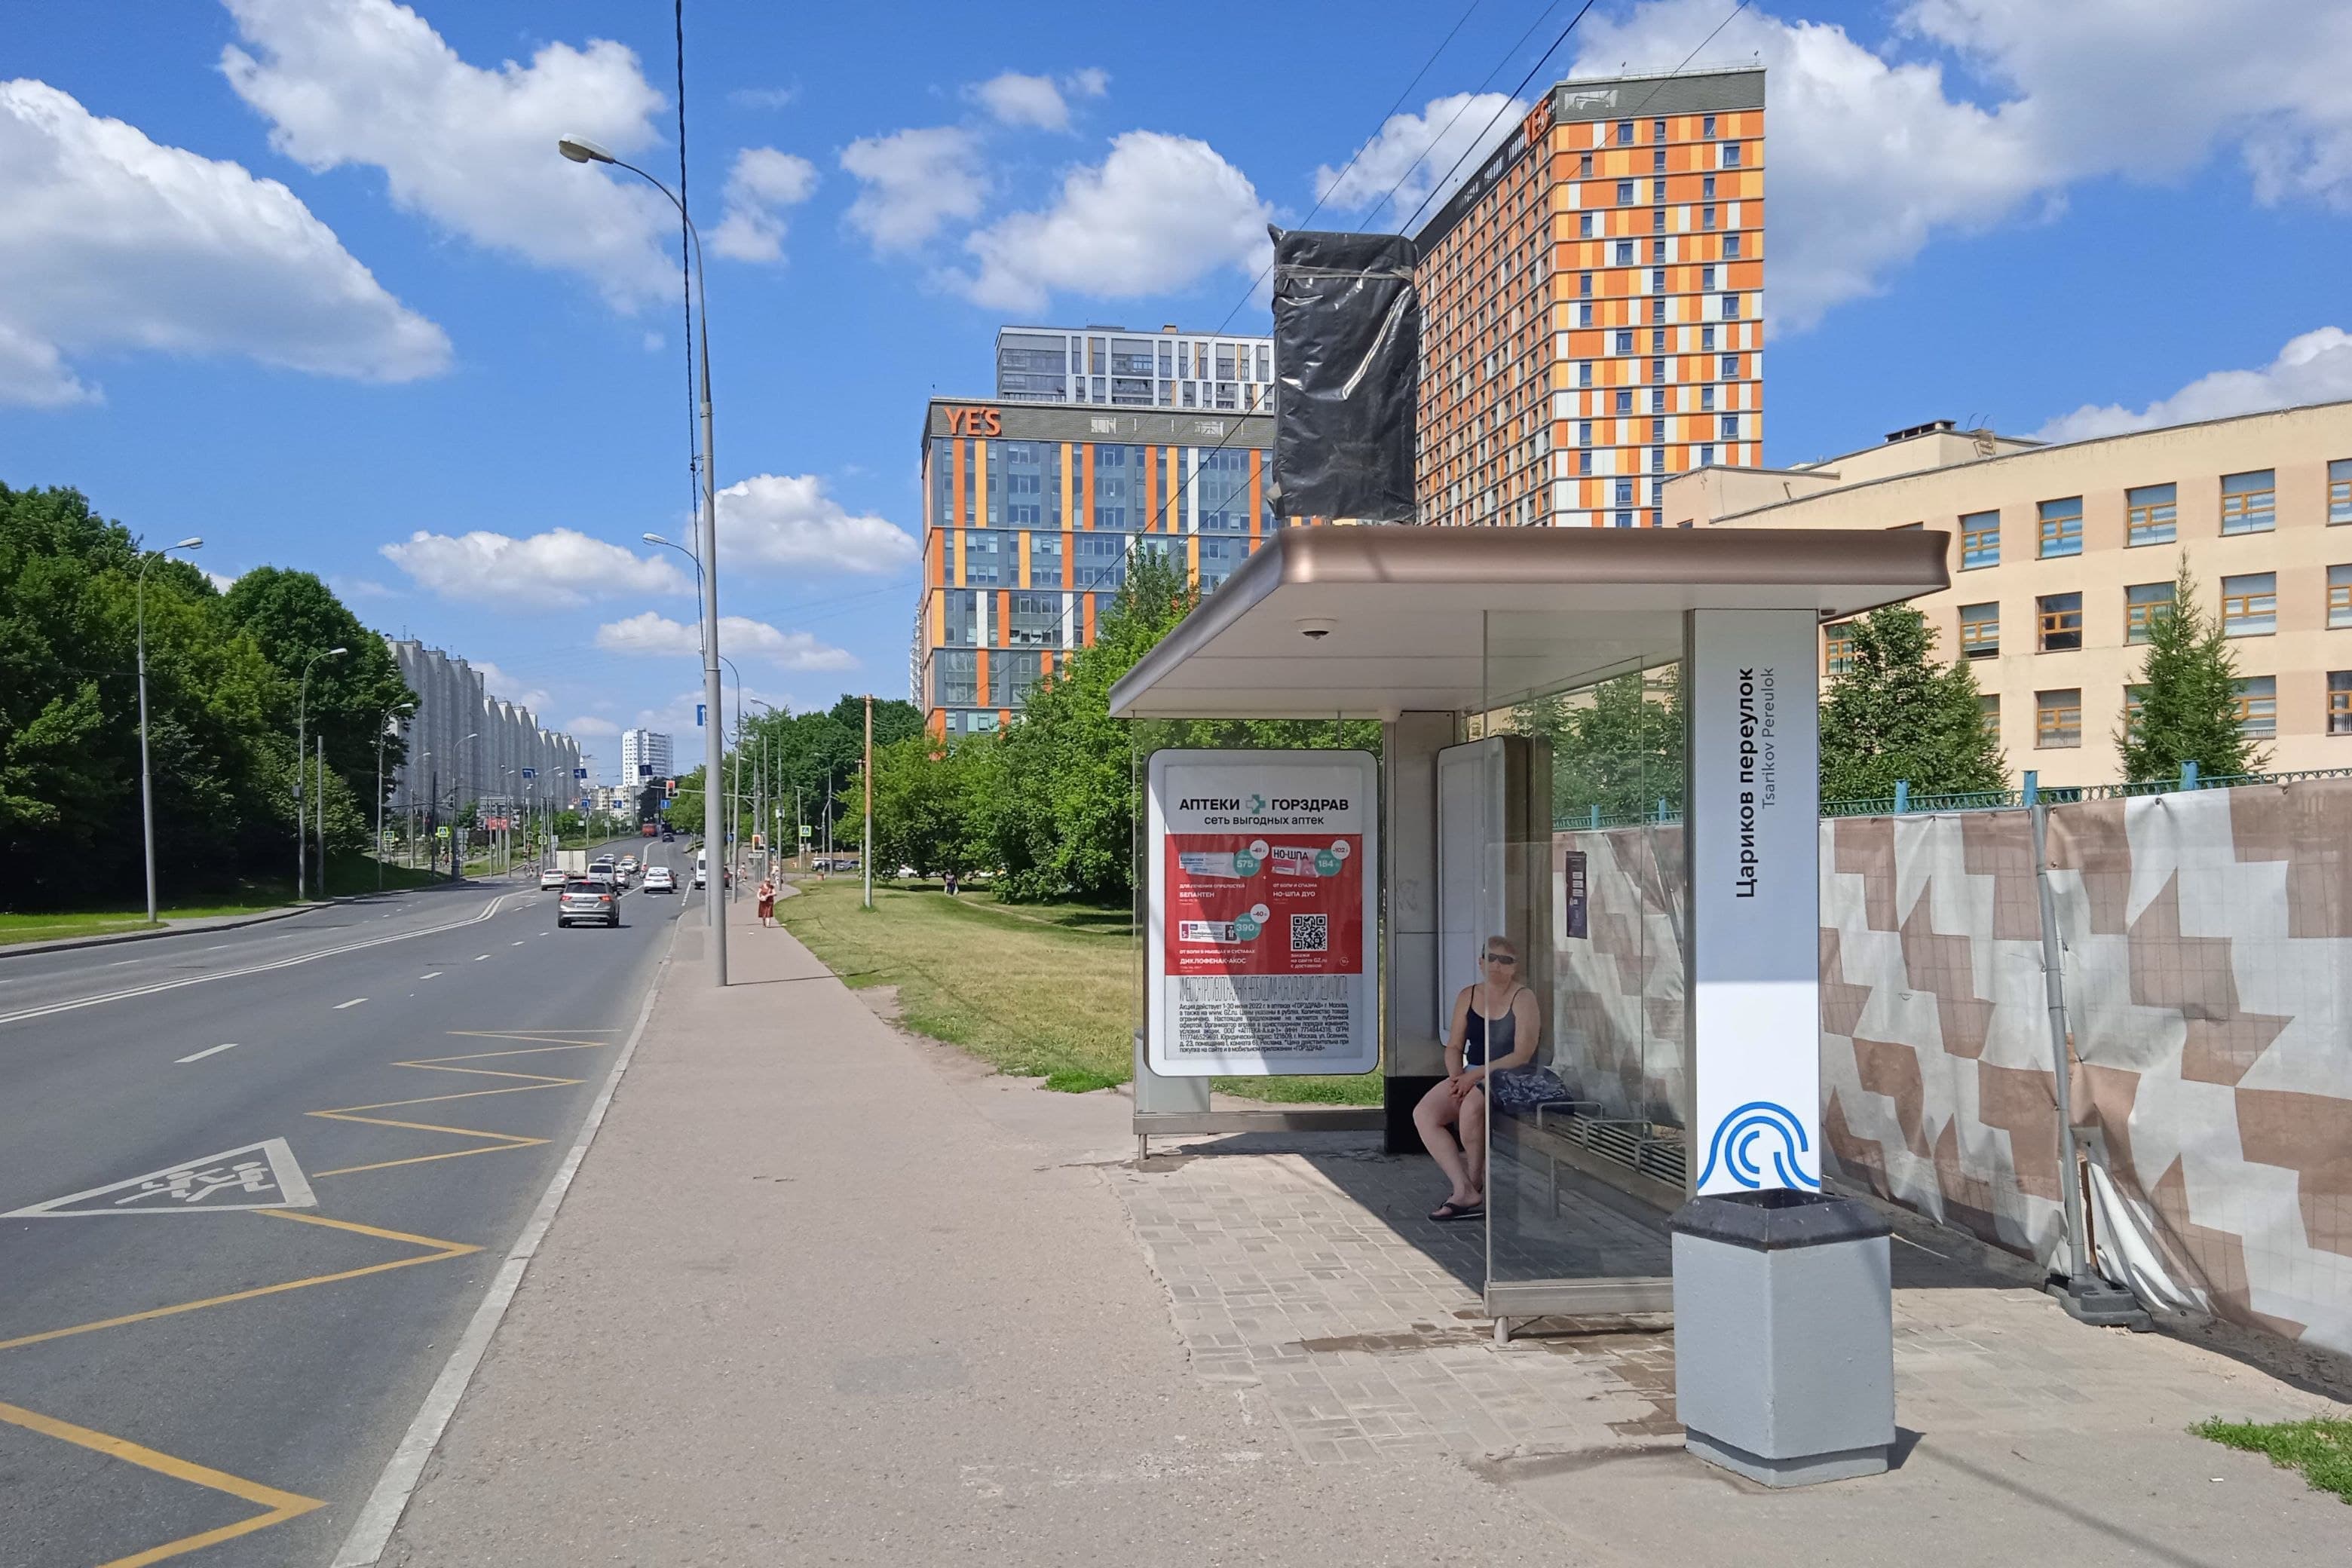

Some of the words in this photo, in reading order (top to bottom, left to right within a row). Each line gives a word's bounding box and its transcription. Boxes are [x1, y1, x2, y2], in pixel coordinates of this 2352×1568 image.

[1760, 668, 1775, 737] Pereulok
[1740, 668, 1758, 783] переулок
[1761, 743, 1775, 810] Tsarikov
[1179, 798, 1240, 810] АПТЕКИ
[1272, 798, 1349, 813] ГОРЗДРАВ
[1204, 816, 1230, 825] сеть
[1233, 816, 1289, 826] выгодных
[1291, 816, 1324, 825] аптек
[1736, 792, 1758, 898] Цариков
[1273, 849, 1309, 860] НО-ШПА
[1236, 860, 1254, 868] 575
[1236, 923, 1254, 932] 390
